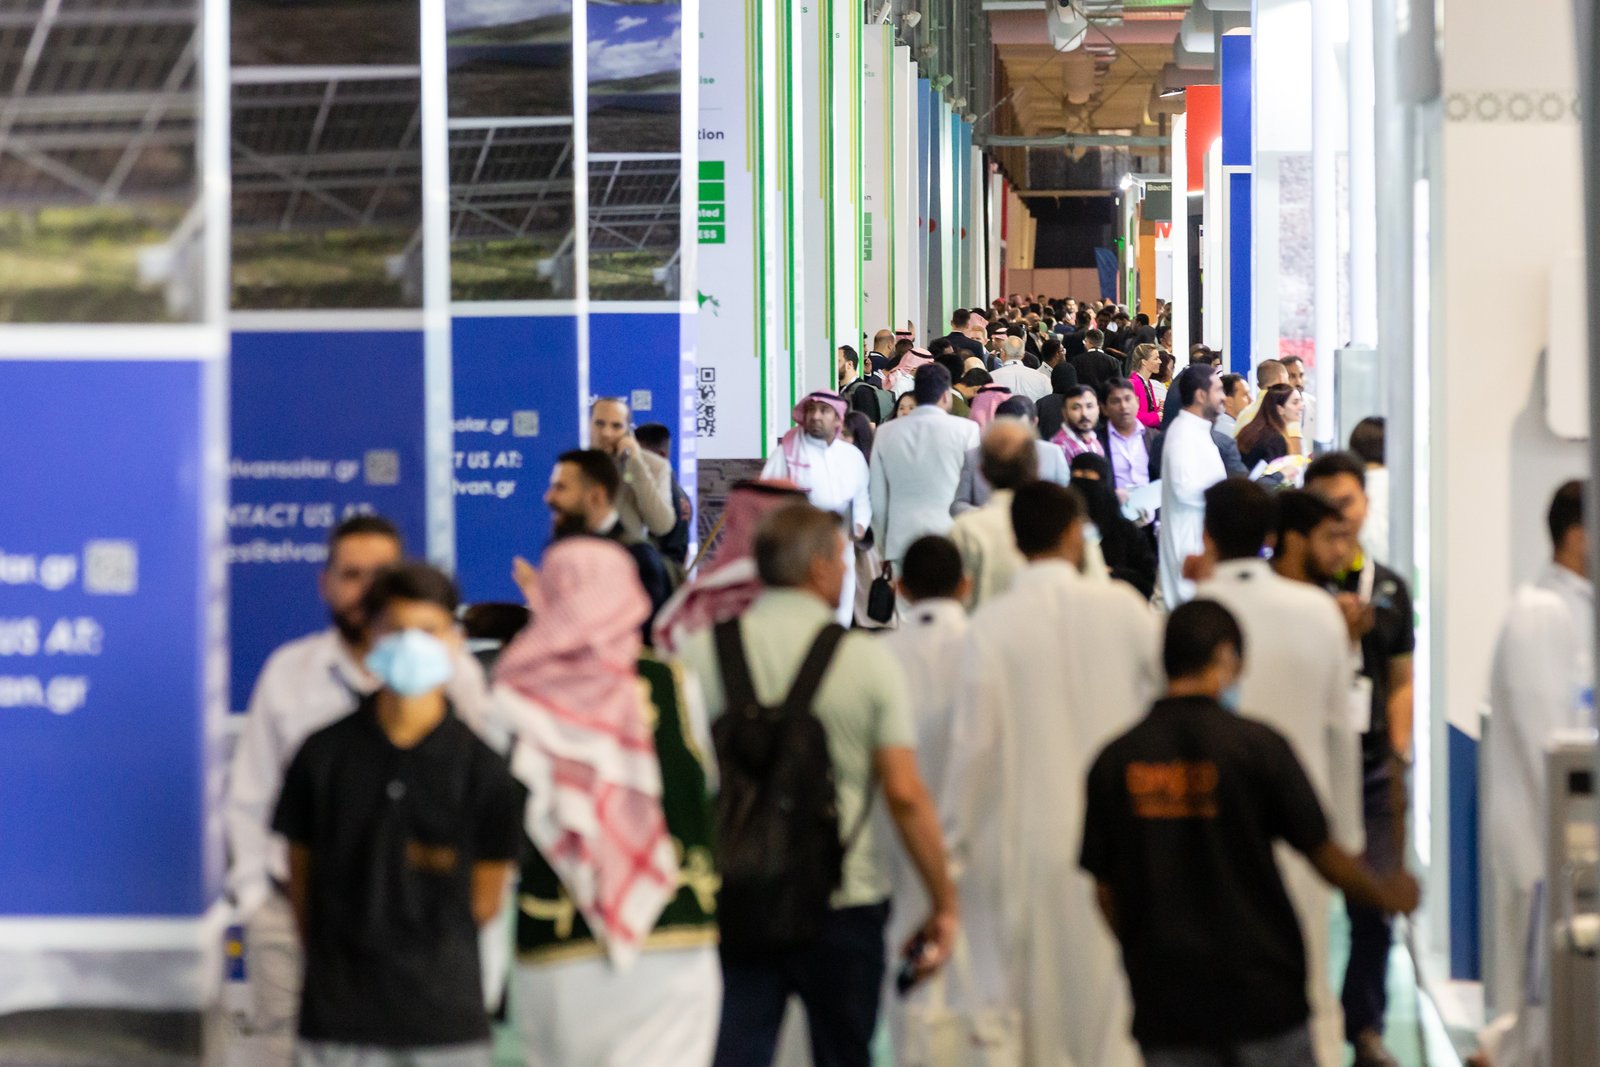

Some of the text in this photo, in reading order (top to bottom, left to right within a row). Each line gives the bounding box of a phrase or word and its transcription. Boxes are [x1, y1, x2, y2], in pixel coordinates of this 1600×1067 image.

[698, 128, 725, 140] tion
[467, 451, 491, 469] US
[493, 450, 524, 469] AT:
[303, 503, 336, 529] US
